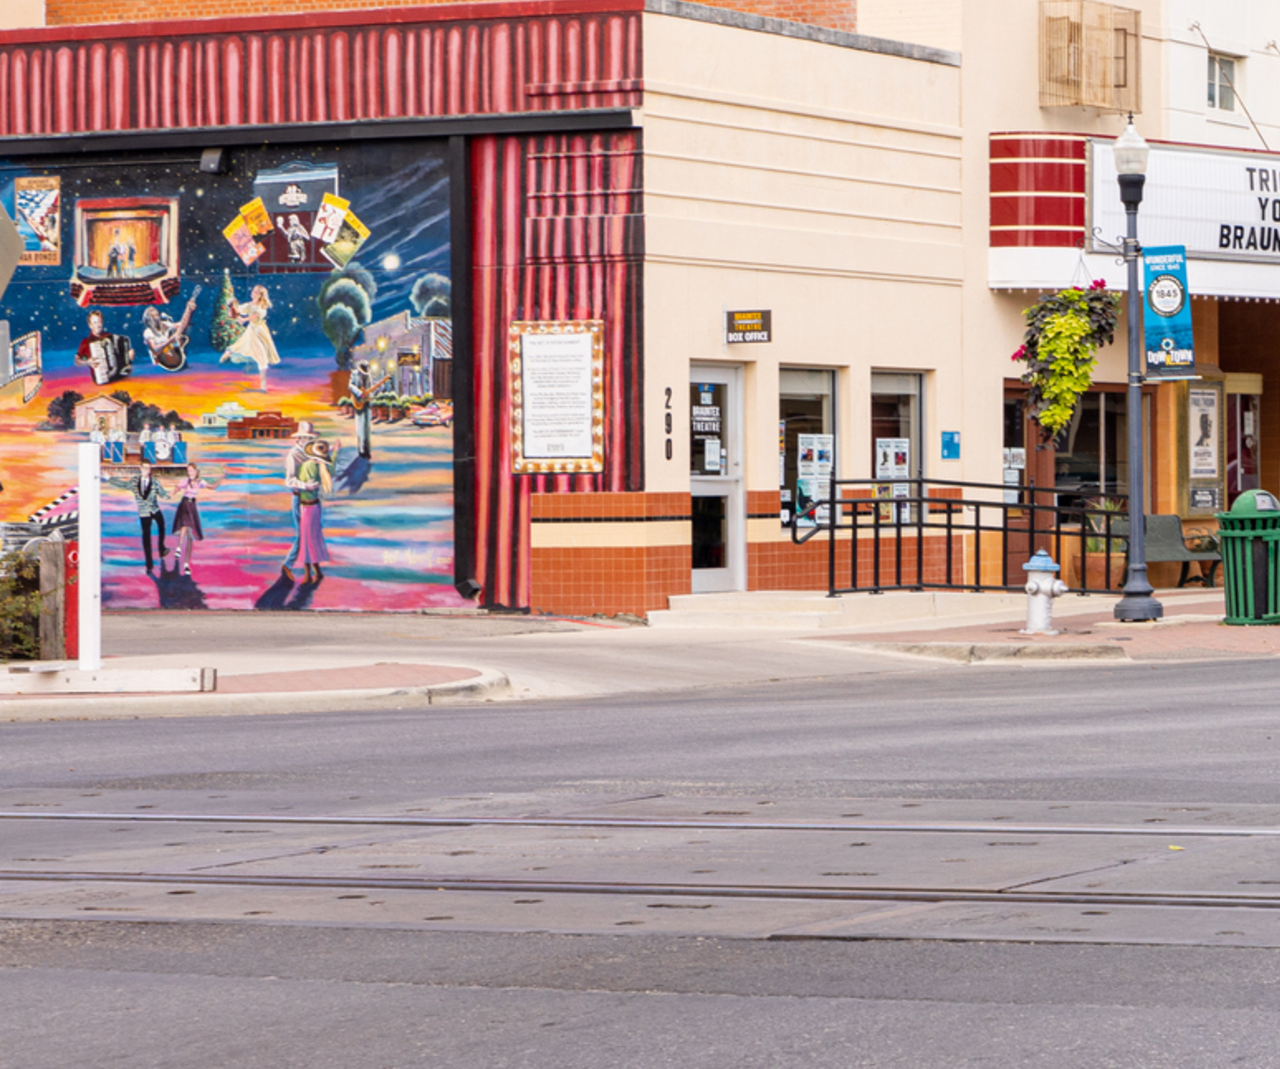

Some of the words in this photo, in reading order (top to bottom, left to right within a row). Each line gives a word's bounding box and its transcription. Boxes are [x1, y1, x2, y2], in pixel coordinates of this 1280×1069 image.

[1156, 289, 1178, 299] 1845
[728, 332, 743, 342] BOX
[744, 331, 768, 341] OFFICE
